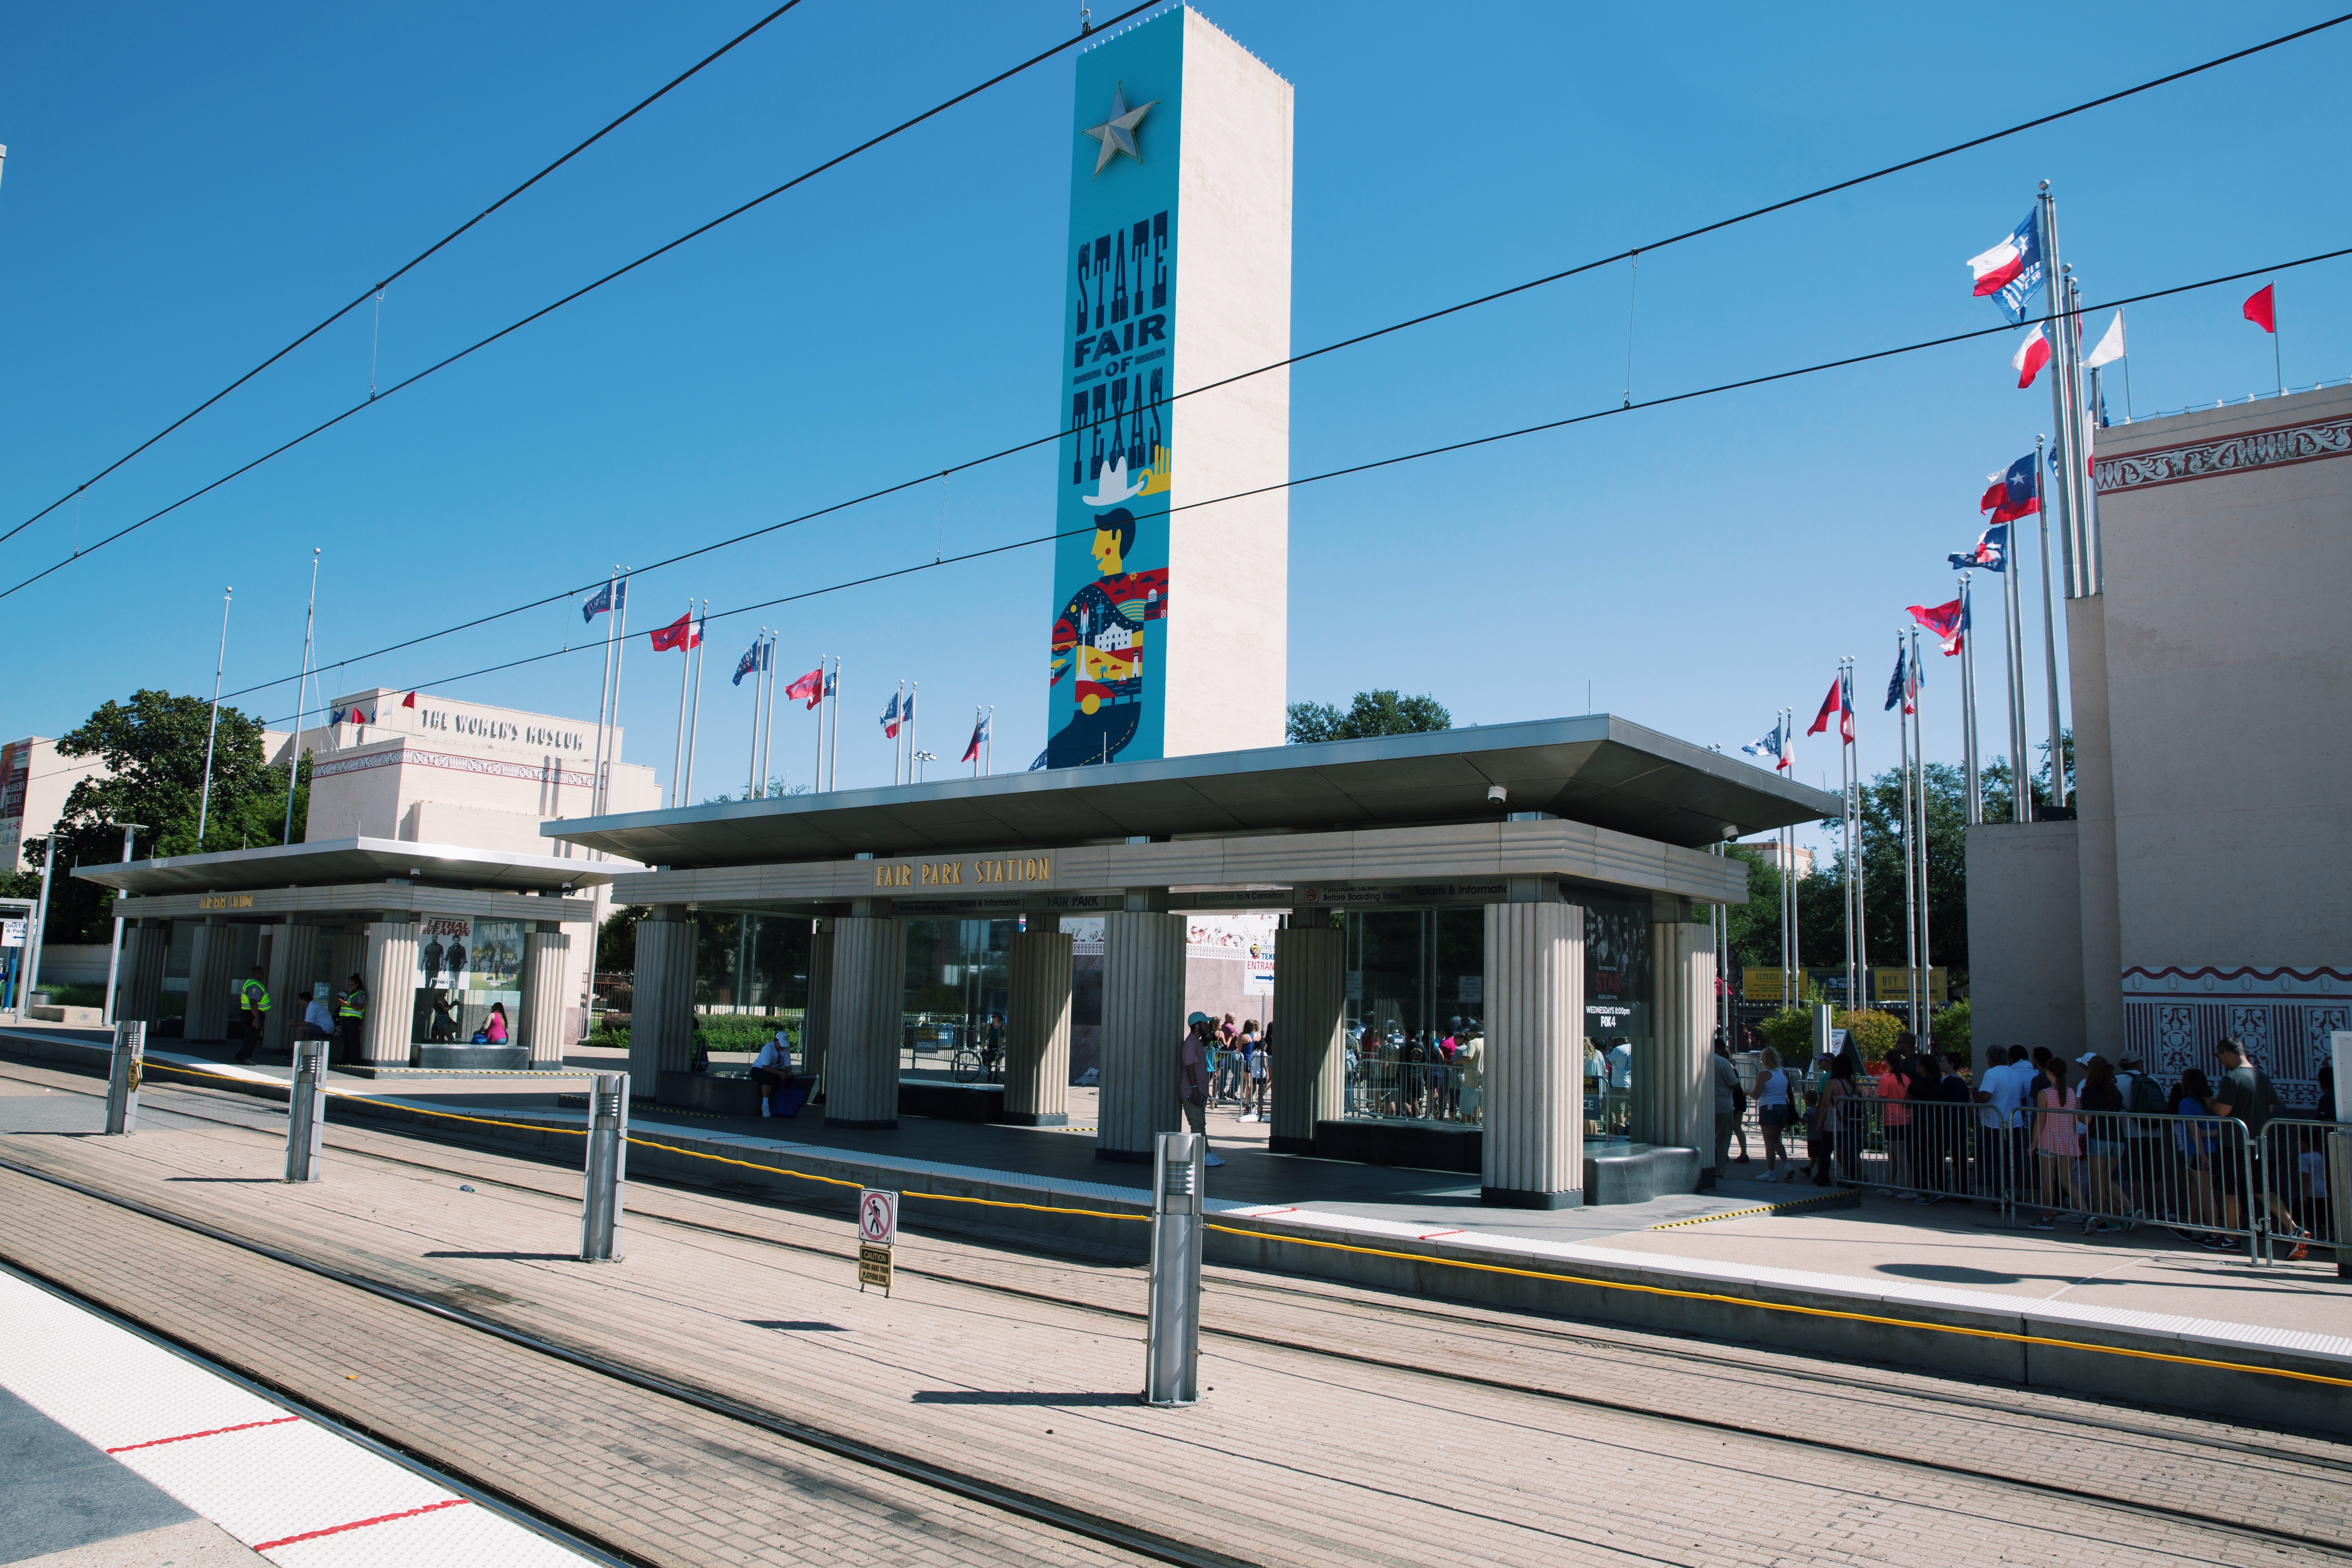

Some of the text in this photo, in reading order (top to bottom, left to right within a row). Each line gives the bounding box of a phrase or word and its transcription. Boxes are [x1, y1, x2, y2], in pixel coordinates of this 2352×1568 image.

[1076, 210, 1168, 336] STATE
[1074, 314, 1166, 368] FAIR
[1105, 356, 1133, 377] OF
[1072, 367, 1163, 485] TEXAS
[422, 709, 583, 751] THE WOMEN'S MUSEUM
[340, 804, 361, 826] 1856
[877, 857, 1050, 887] FAIR PARK STATION
[1348, 893, 1380, 901] Boarding
[1414, 886, 1507, 897] Tickets & Informatio
[200, 895, 253, 909] FAIR PARK STATION
[1047, 895, 1098, 907] FAIR PARK
[428, 920, 469, 929] LETHAL
[422, 927, 470, 937] WEAPON
[483, 923, 518, 940] MICK
[1247, 961, 1275, 970] ENTRAN
[1595, 973, 1621, 993] STAR
[1882, 976, 1898, 986] BUY
[1586, 1006, 1630, 1016] WEDNESDAYS 8:00pm
[864, 1251, 886, 1262] CAUTION
[861, 1262, 889, 1274] STAND AWAY FROM
[863, 1271, 878, 1281] PLATFORM
